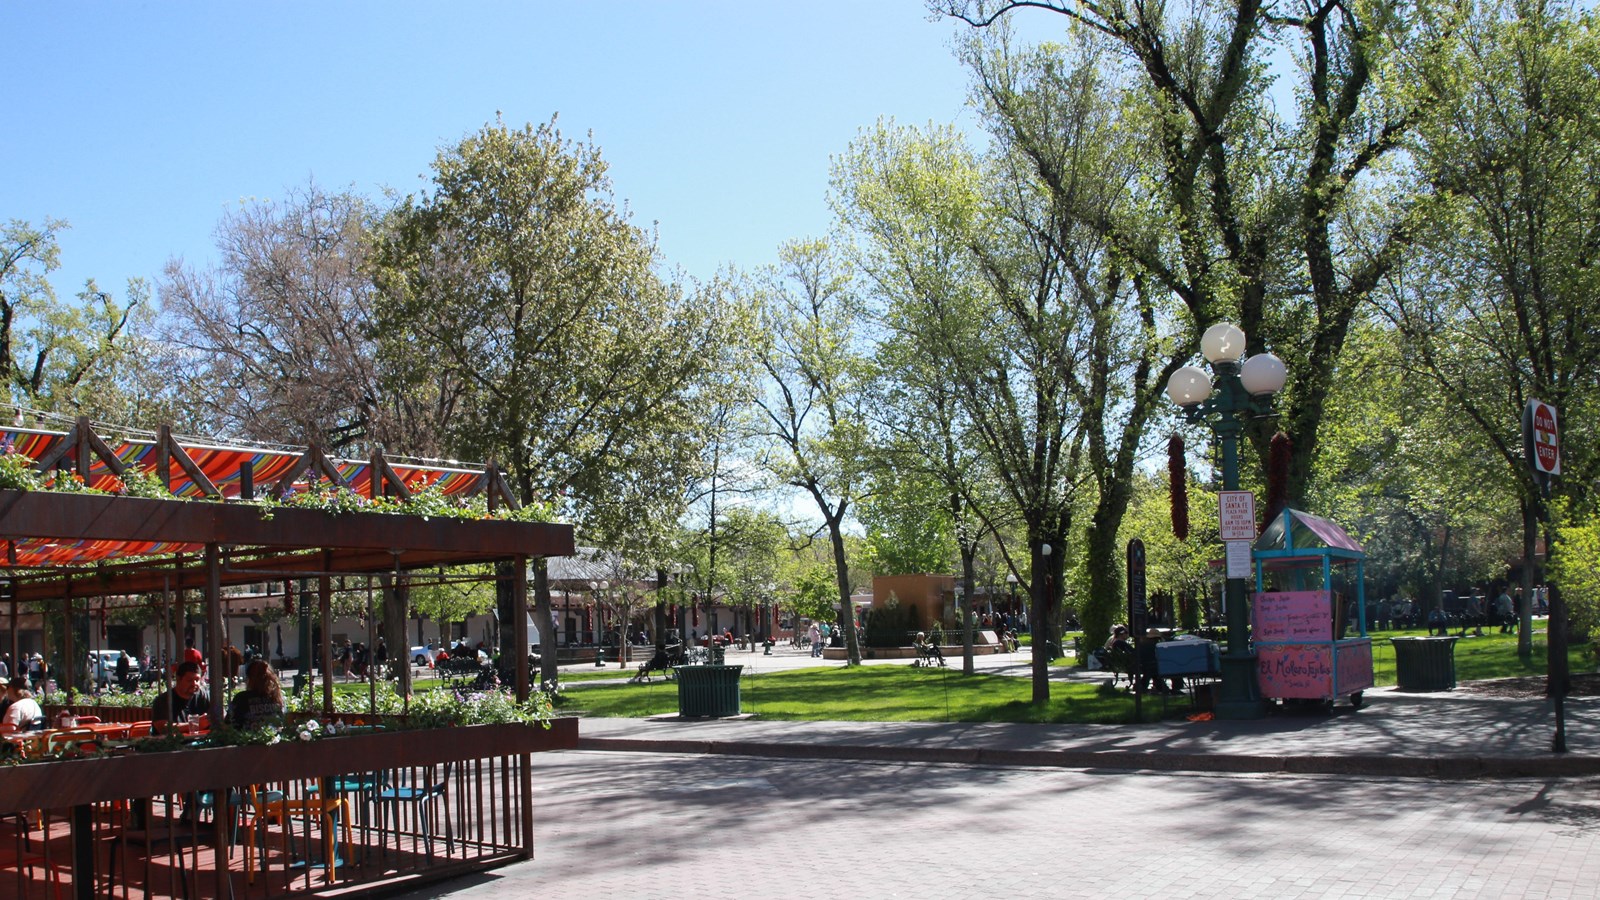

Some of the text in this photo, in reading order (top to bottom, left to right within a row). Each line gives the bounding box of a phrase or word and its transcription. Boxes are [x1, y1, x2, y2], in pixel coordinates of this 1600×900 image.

[1536, 415, 1553, 430] DO NOT
[1539, 446, 1554, 459] ENTER
[1260, 660, 1272, 675] El
